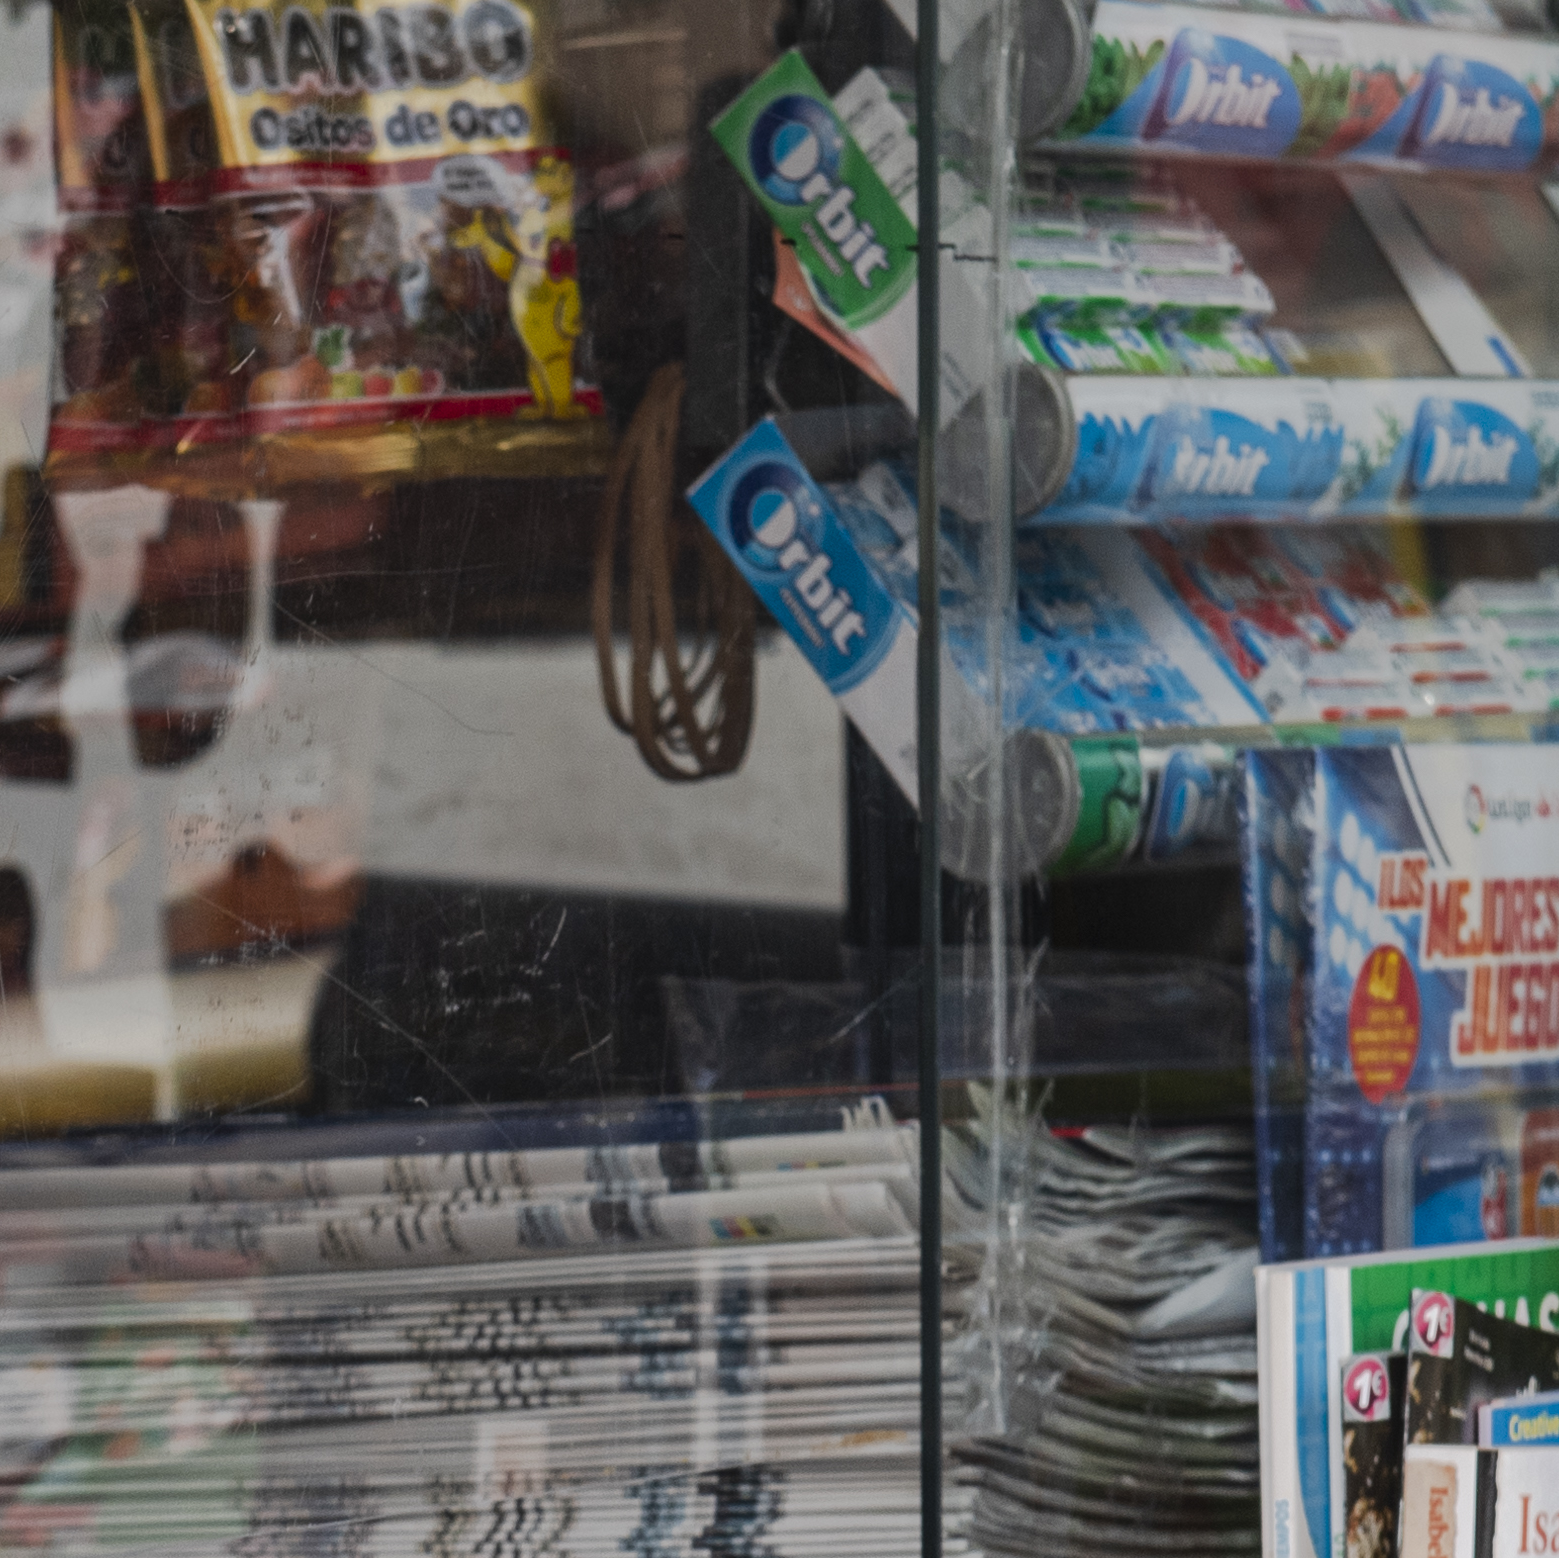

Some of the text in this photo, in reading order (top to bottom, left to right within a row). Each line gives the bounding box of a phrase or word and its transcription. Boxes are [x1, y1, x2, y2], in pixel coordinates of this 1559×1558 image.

[222, 0, 533, 95] HARIBO
[249, 98, 530, 154] Ositos de Oro
[747, 94, 891, 290] Orbit
[726, 460, 866, 656] Orbit
[1353, 1369, 1388, 1413] 1€
